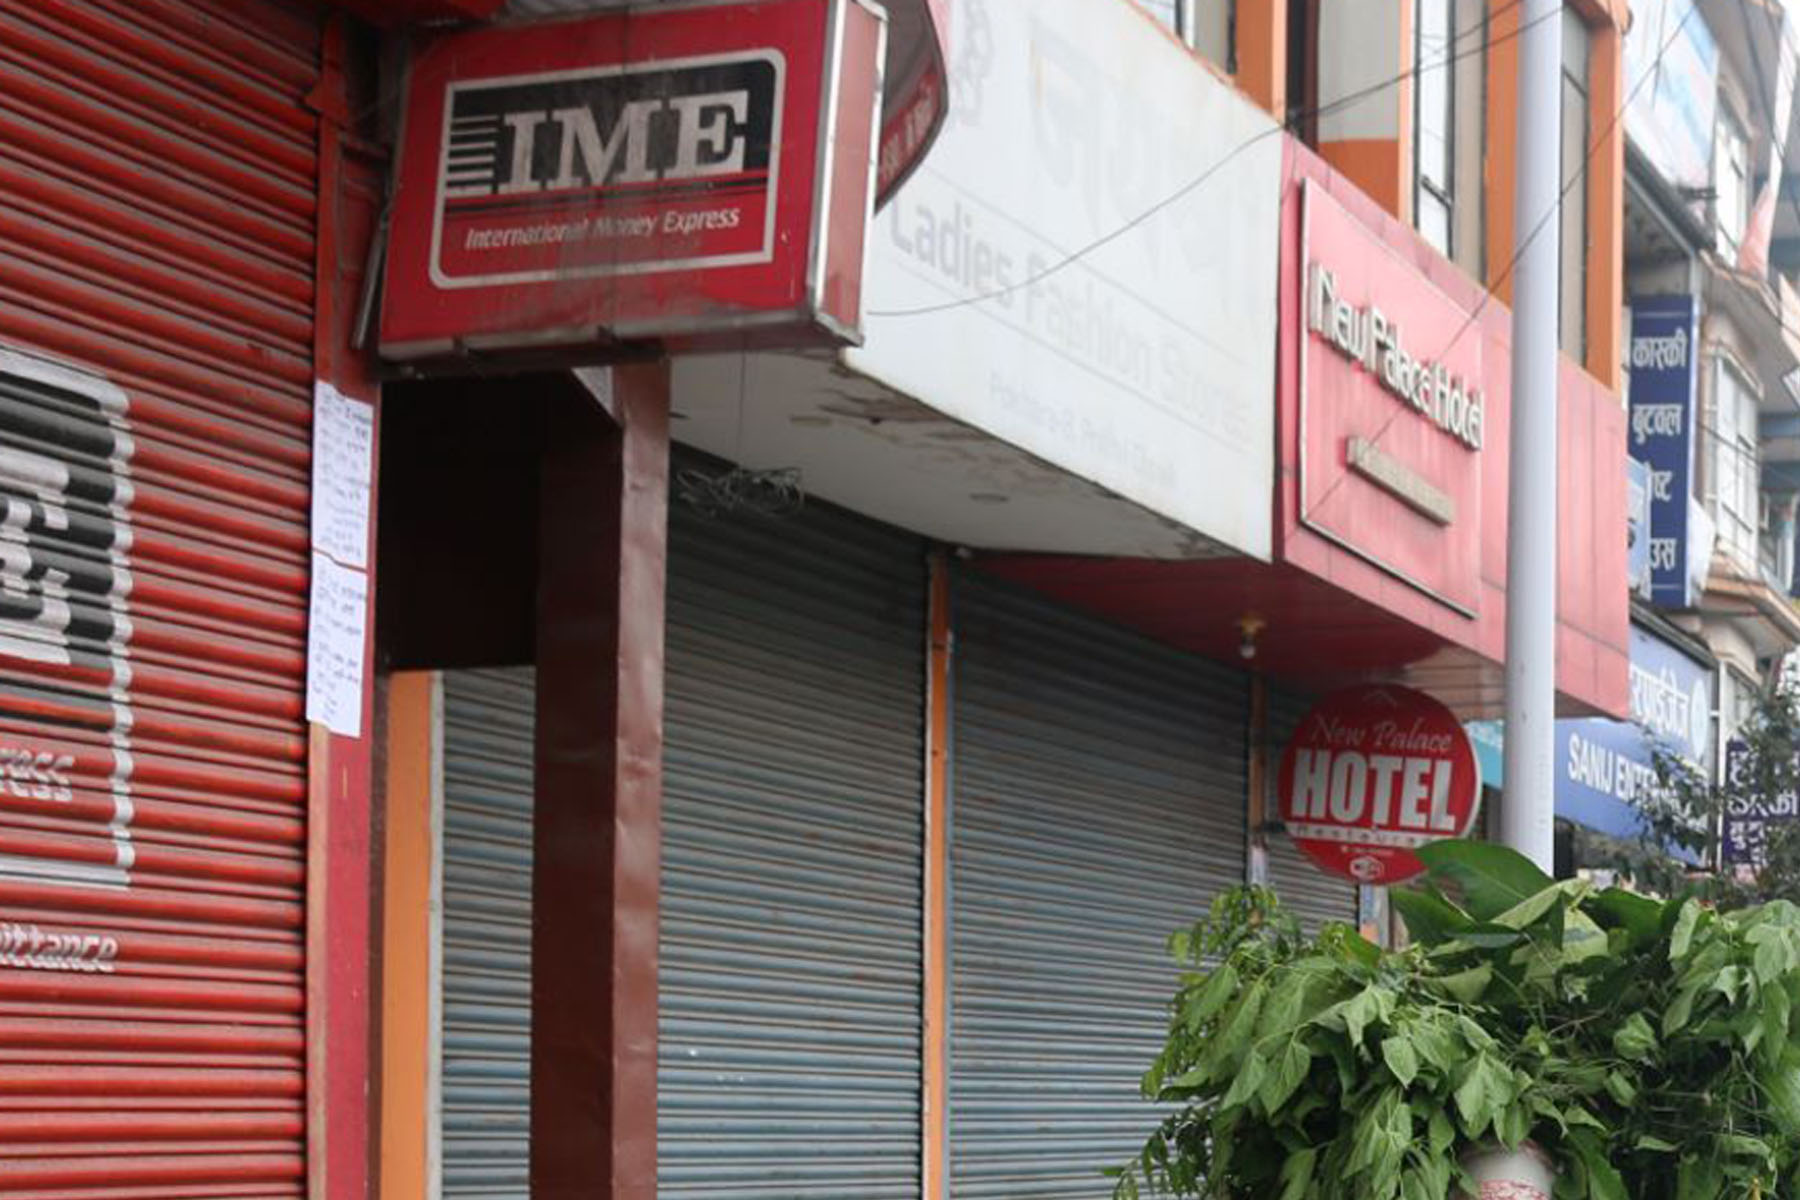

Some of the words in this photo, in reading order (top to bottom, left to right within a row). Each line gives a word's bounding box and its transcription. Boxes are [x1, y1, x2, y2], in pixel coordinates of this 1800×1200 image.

[497, 90, 749, 194] IME
[465, 217, 589, 250] International
[592, 215, 657, 237] Money
[662, 207, 740, 235] Express
[889, 190, 1014, 311] Ladies
[1309, 261, 1367, 362] New
[1366, 306, 1432, 417] Palace
[1430, 360, 1484, 451] Hotel
[1631, 327, 1688, 370] कास्की
[1631, 403, 1682, 445] बुटवल
[1310, 712, 1367, 747] New
[1372, 716, 1453, 753] Palace
[1291, 747, 1457, 832] HOTEL
